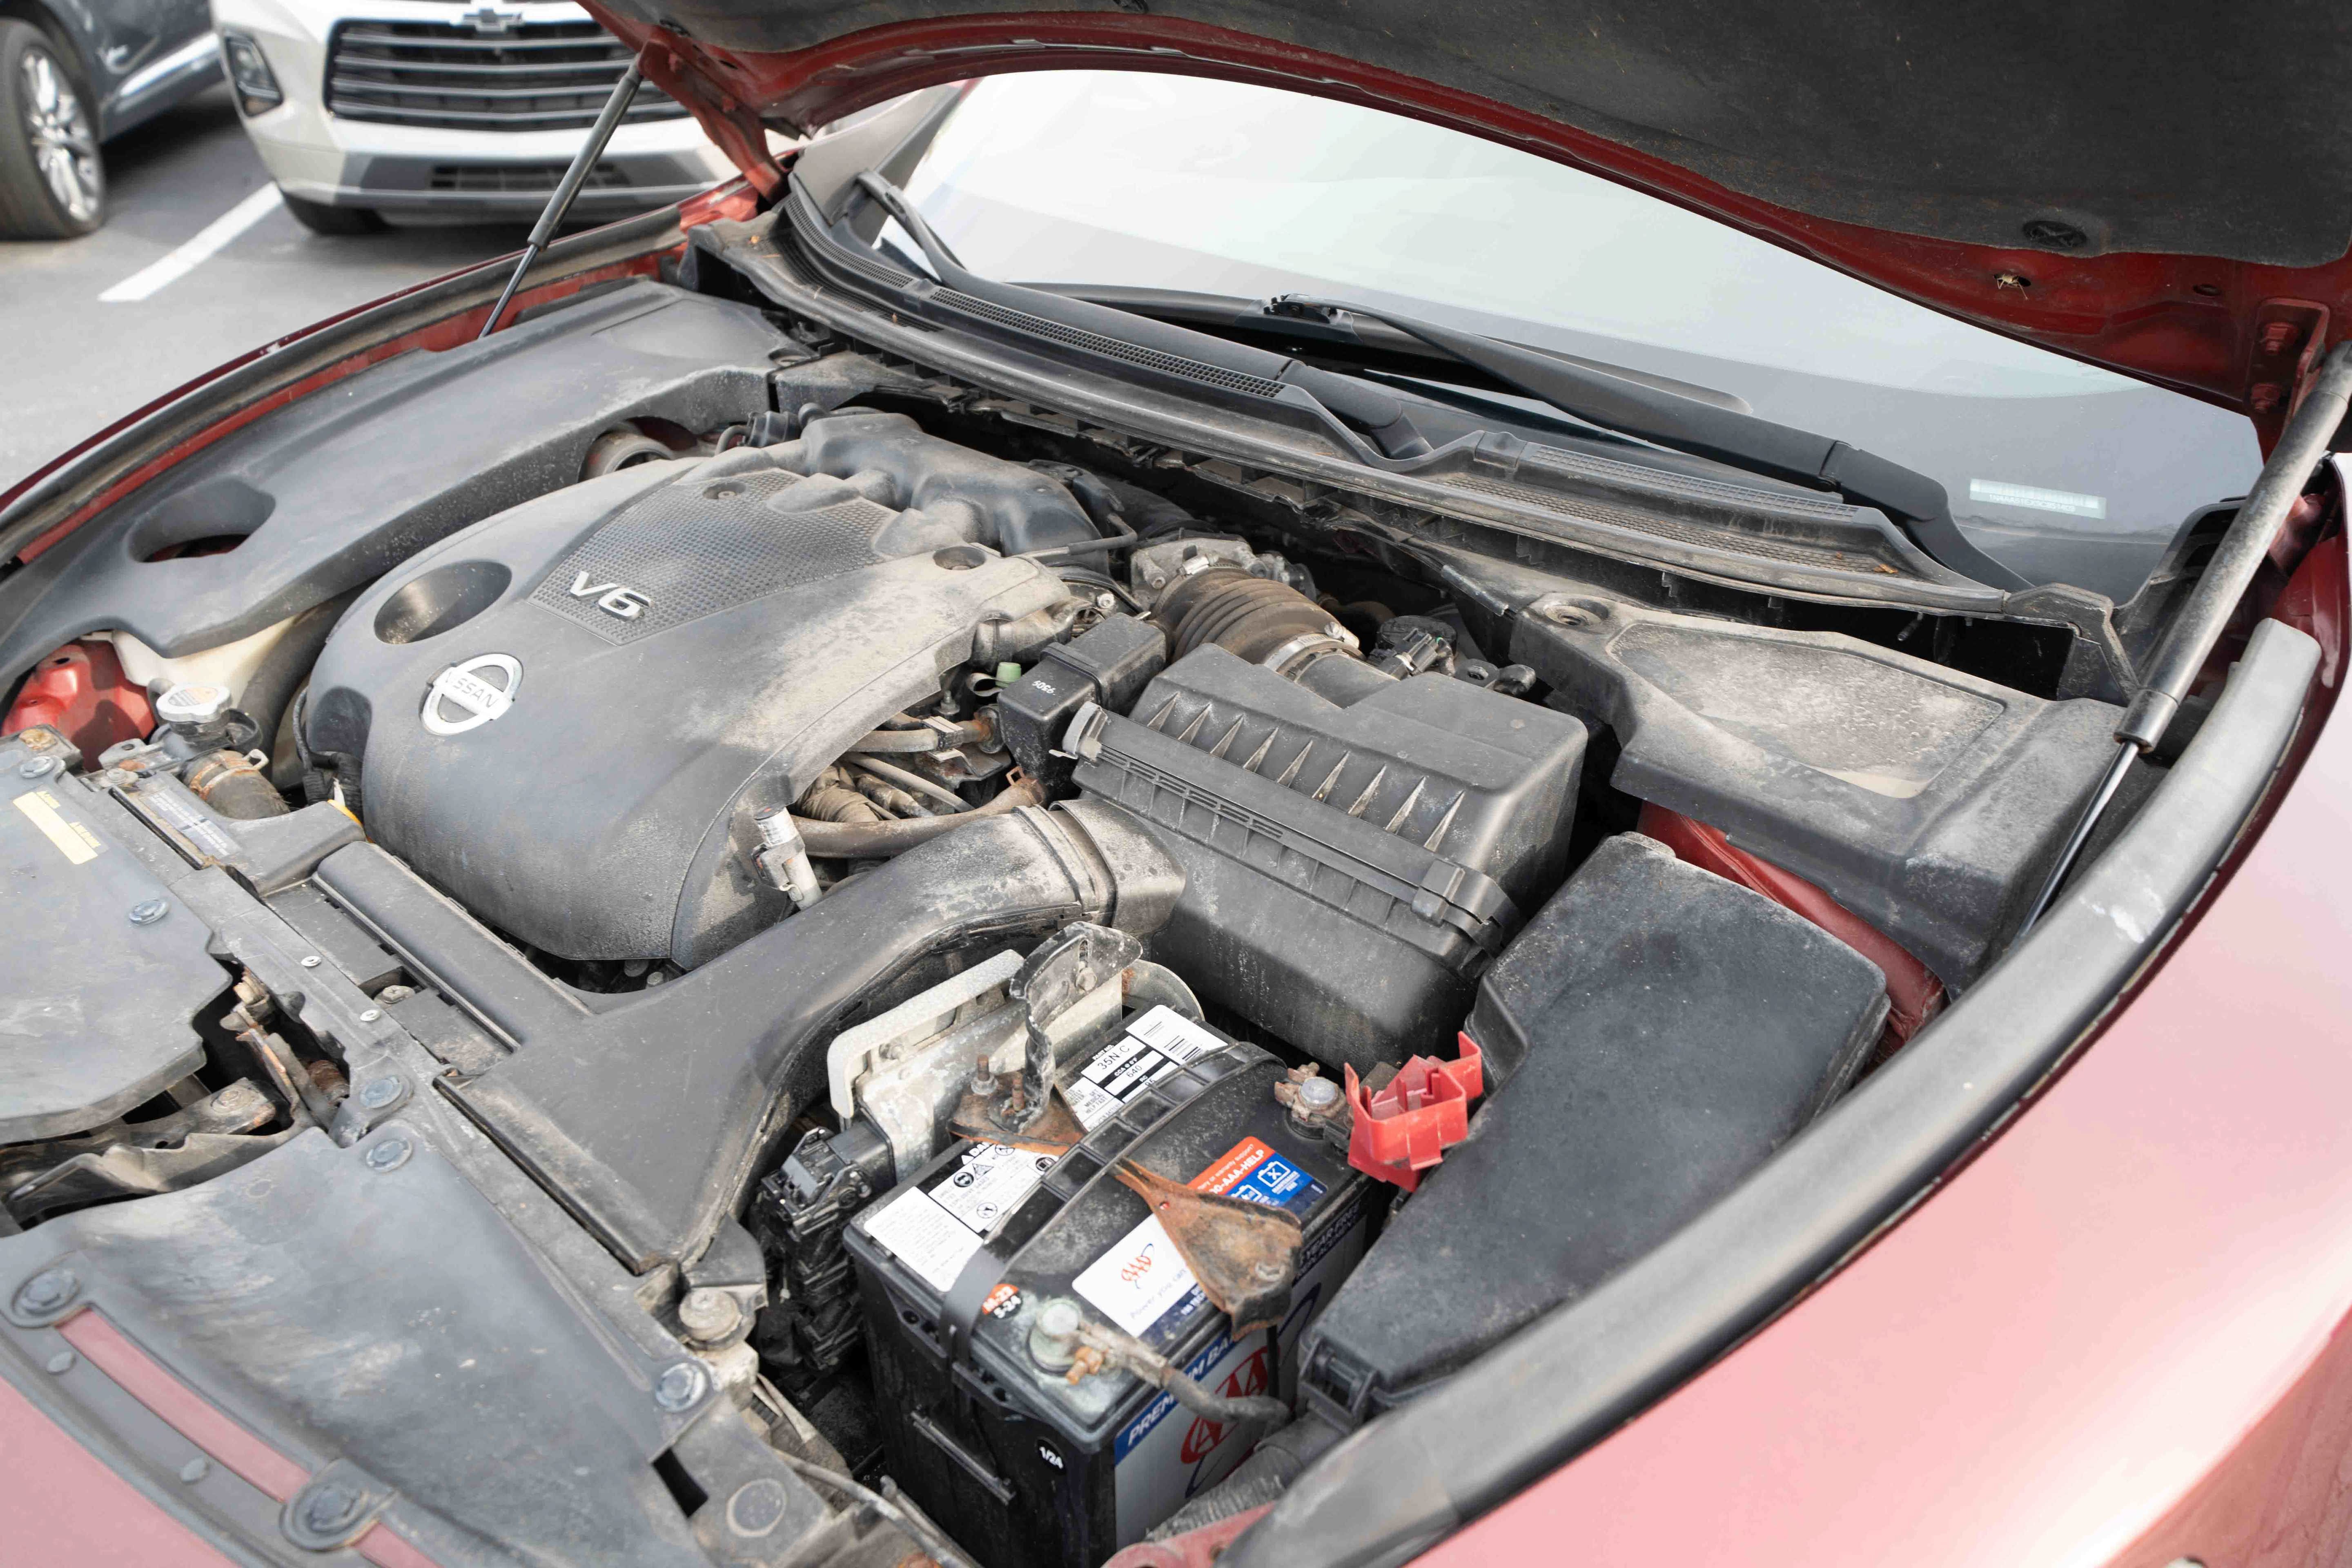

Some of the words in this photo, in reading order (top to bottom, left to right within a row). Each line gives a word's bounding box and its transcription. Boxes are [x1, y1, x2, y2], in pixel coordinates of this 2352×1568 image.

[570, 571, 653, 619] V6
[1097, 1045, 1130, 1070] 35N-C
[1126, 1065, 1143, 1078] 640
[1039, 1446, 1064, 1469] 1/24
